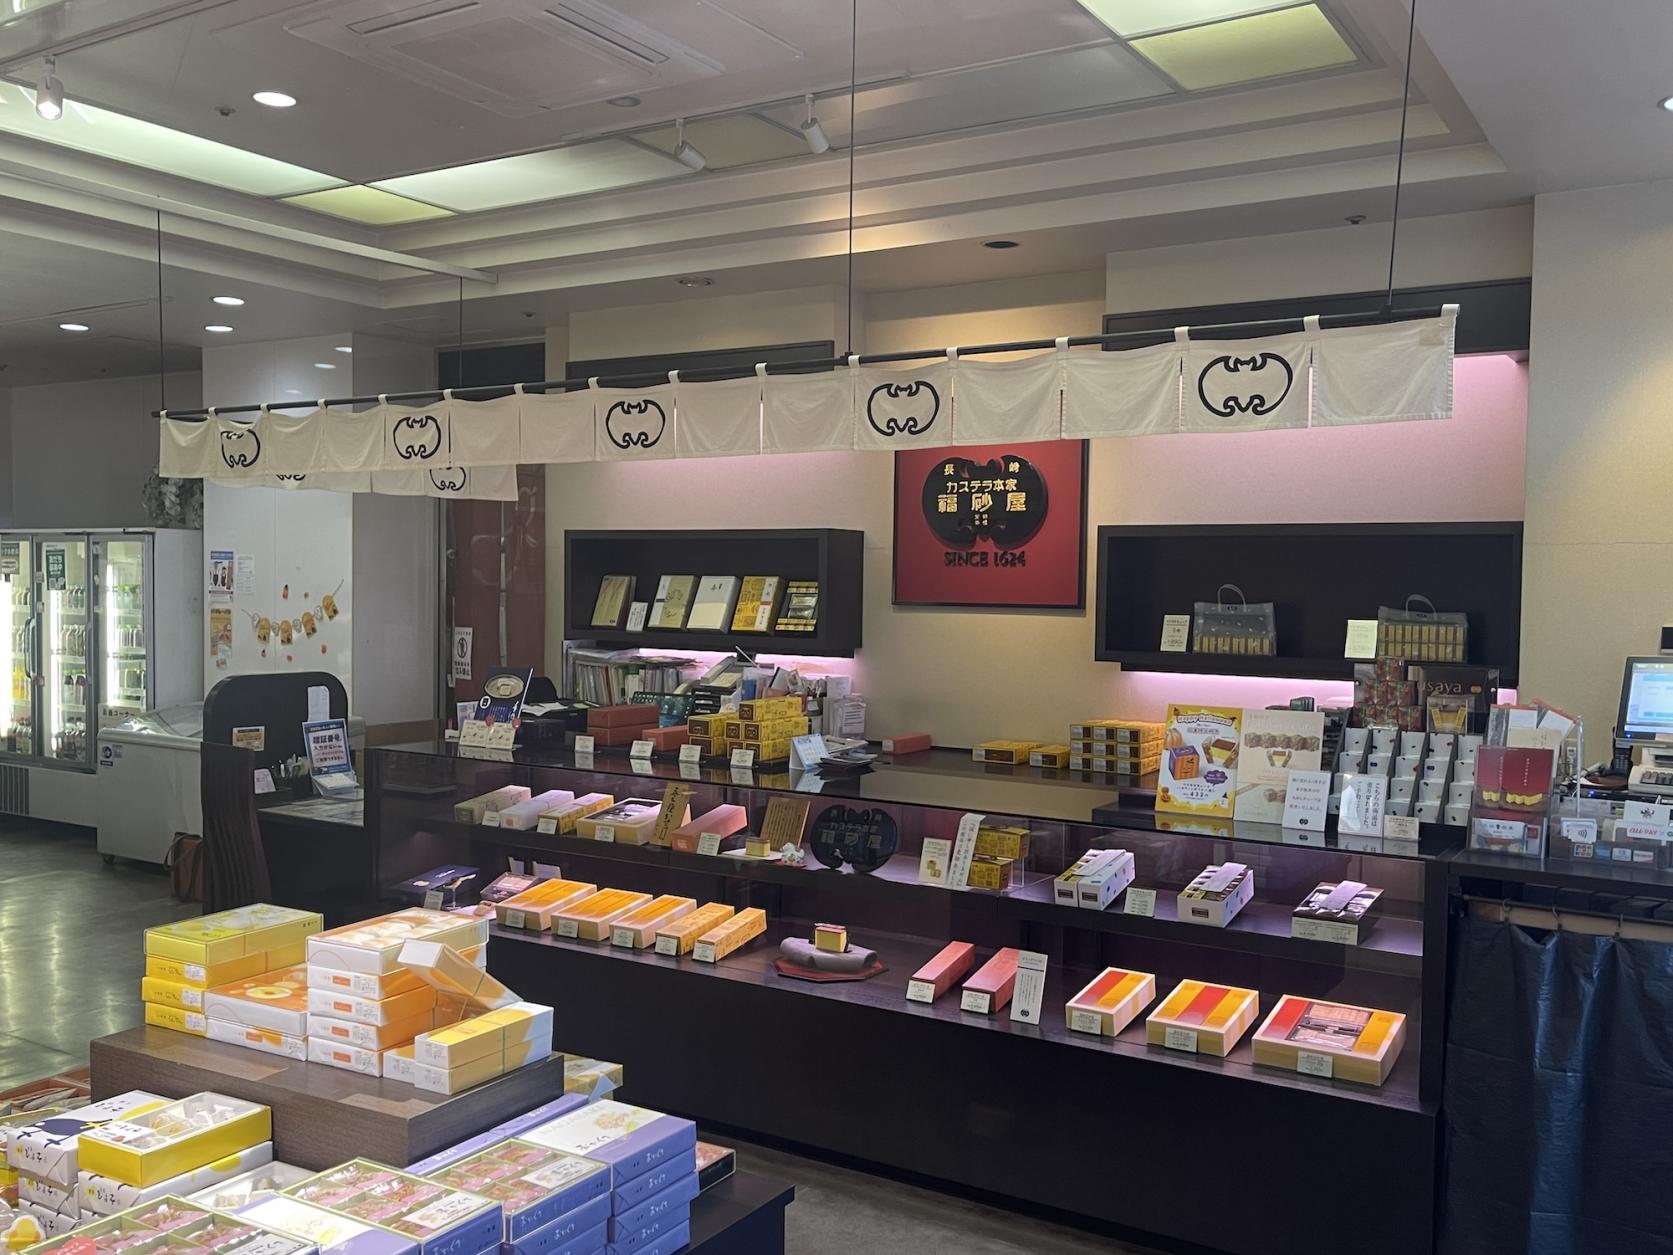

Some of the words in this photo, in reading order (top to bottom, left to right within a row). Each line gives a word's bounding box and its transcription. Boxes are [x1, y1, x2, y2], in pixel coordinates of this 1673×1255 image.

[944, 463, 955, 475] 長
[946, 479, 1018, 493] カステラ本家
[937, 492, 1026, 512] 福砂屋
[943, 551, 989, 567] SINCE
[993, 551, 1026, 567] 1624
